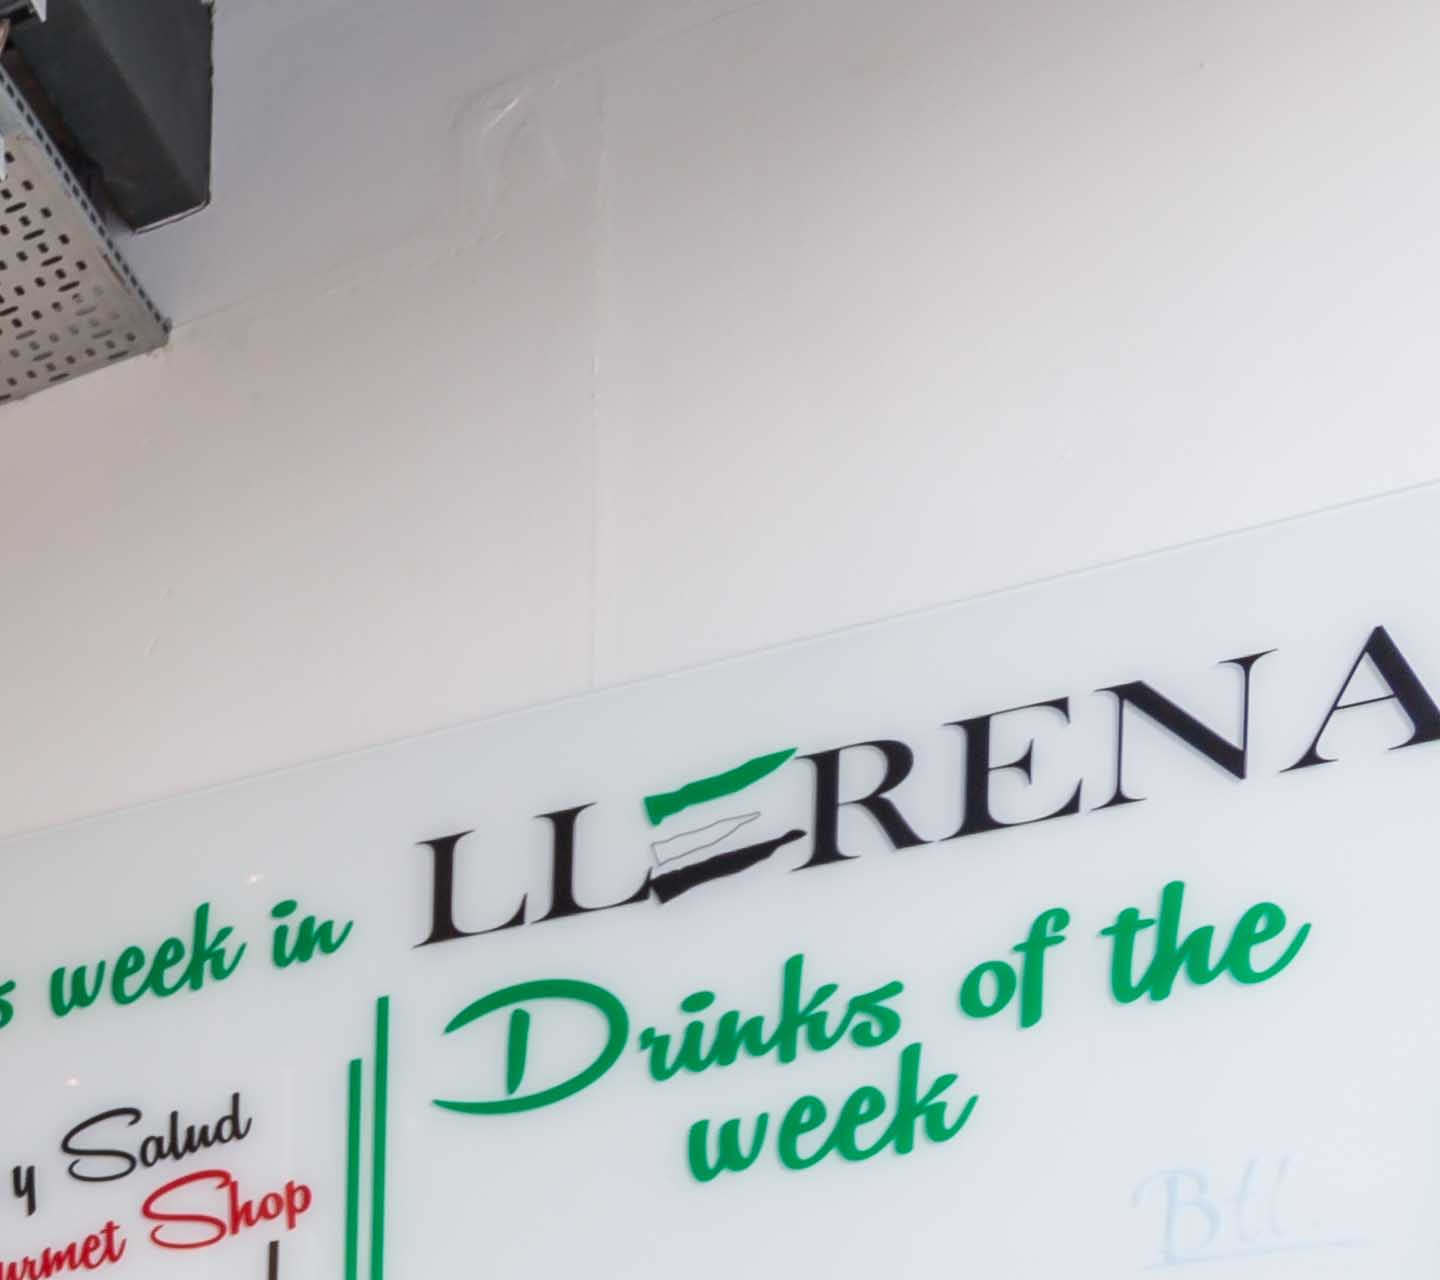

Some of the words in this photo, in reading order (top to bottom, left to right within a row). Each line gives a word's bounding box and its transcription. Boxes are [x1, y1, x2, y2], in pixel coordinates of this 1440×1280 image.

[49, 903, 247, 1017] week
[271, 899, 354, 970] in
[432, 955, 906, 1116] Drinks
[960, 907, 1072, 1030] of
[1100, 880, 1312, 1003] the
[12, 1165, 37, 1217] y
[60, 1092, 252, 1182] Salud
[685, 1042, 979, 1183] week
[141, 1169, 313, 1249] Shop
